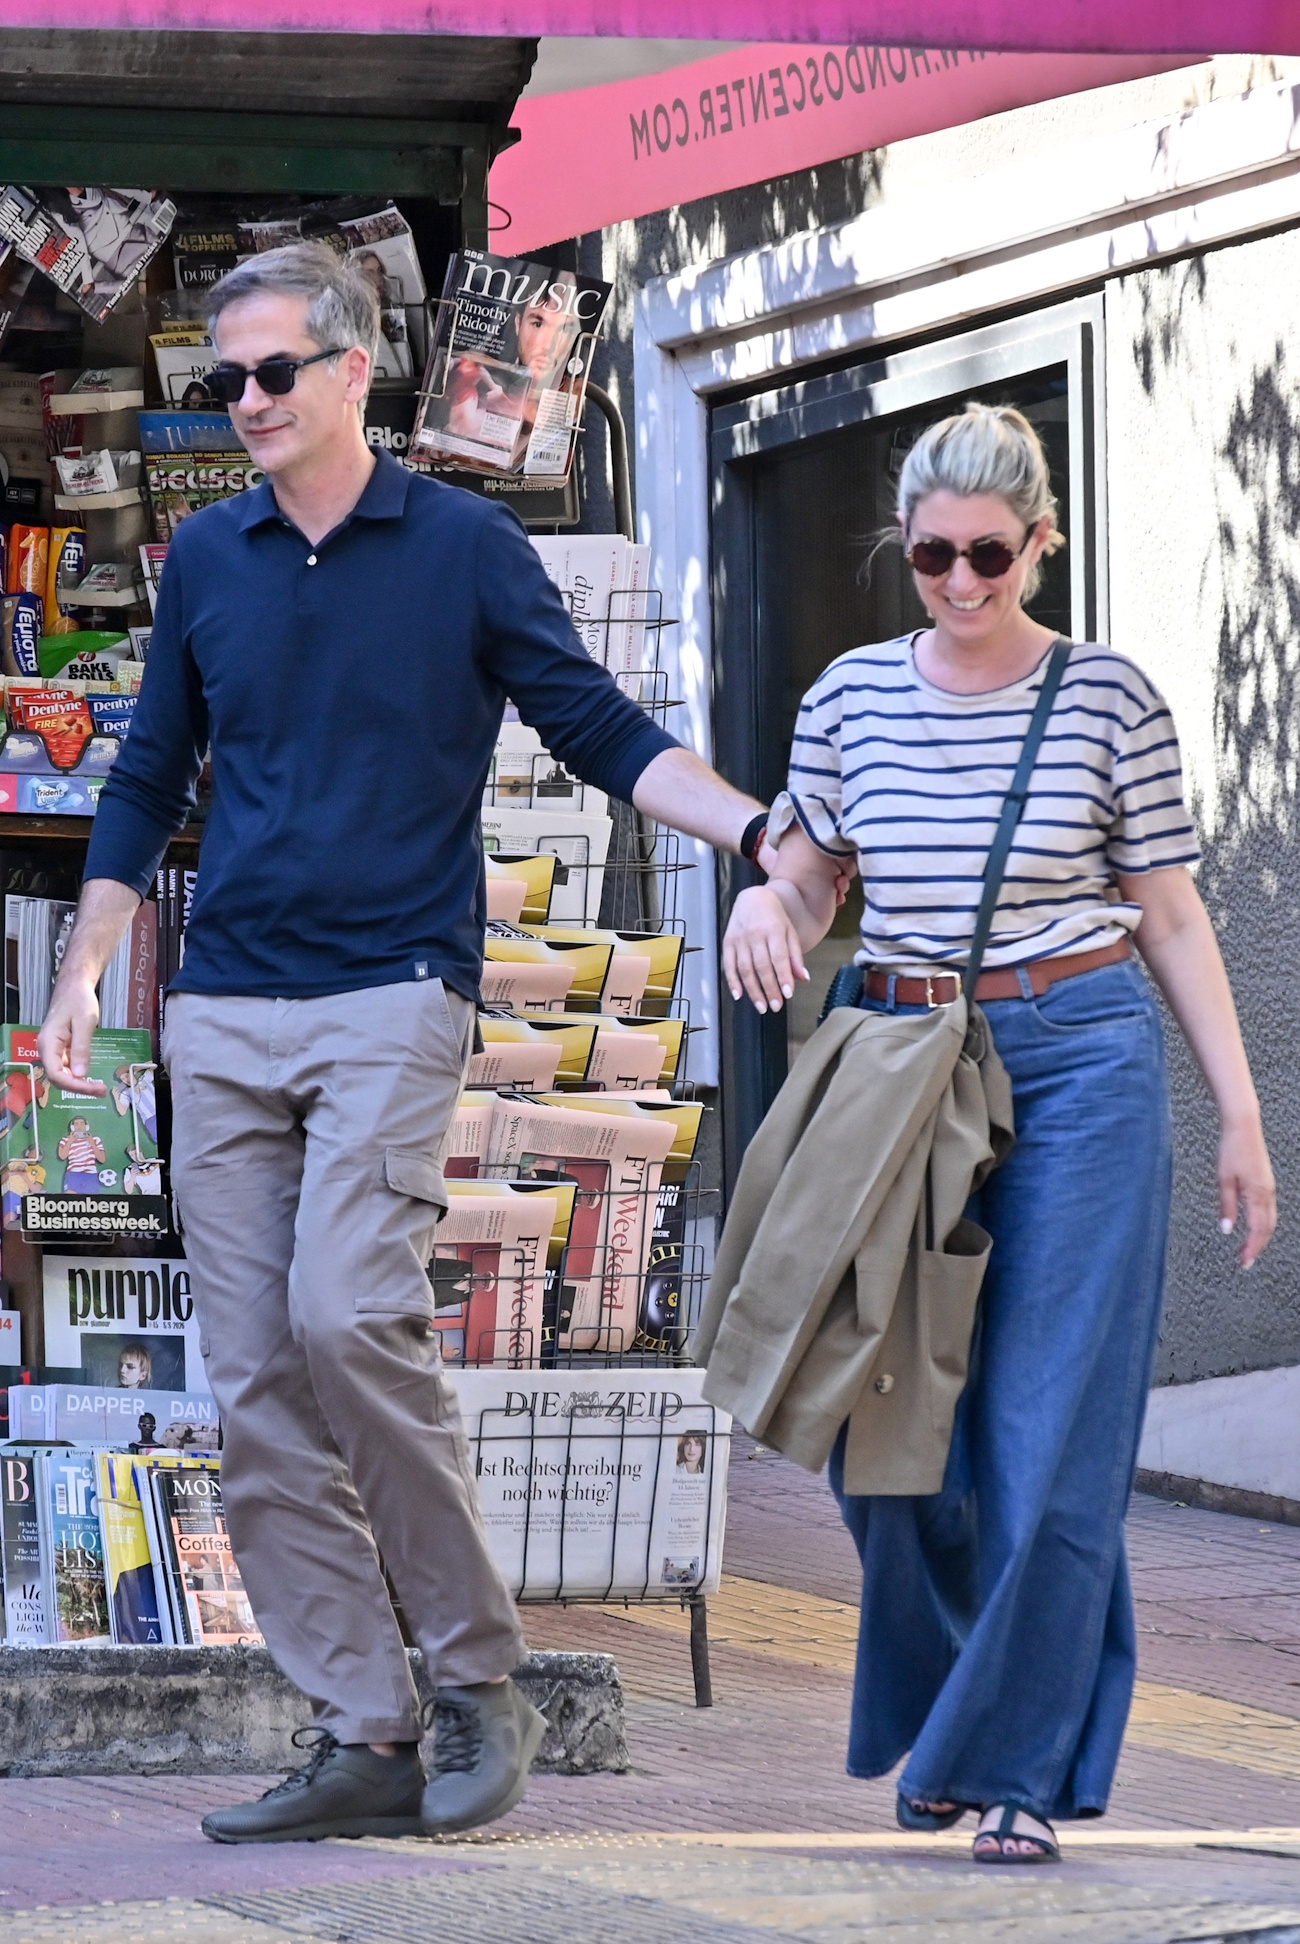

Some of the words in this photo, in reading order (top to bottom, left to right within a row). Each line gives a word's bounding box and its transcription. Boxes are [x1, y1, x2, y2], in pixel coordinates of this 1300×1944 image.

[7, 217, 31, 243] THE
[20, 219, 52, 257] ROOM
[190, 233, 236, 245] FILMS
[189, 244, 238, 252] OFFERTS
[66, 251, 83, 273] VIRAL
[458, 259, 602, 320] music
[457, 297, 511, 325] Timothy
[458, 314, 501, 336] Ridout
[162, 336, 191, 345] FILMS
[568, 576, 594, 635] diplo
[68, 662, 111, 674] BAKE
[29, 701, 82, 717] Dentyne
[93, 697, 138, 713] Dentyn
[35, 719, 58, 729] FIRE
[37, 789, 63, 797] Trident
[135, 921, 150, 984] Paper
[507, 1116, 523, 1150] SpaceX
[26, 1196, 130, 1216] Bloomberg
[27, 1212, 161, 1231] Businessweek
[68, 1263, 194, 1328] purple
[67, 1394, 146, 1415] DAPPER
[170, 1400, 211, 1420] DAN
[503, 1391, 561, 1418] DIE
[604, 1391, 683, 1418] ZEID
[478, 1456, 497, 1477] Ist
[502, 1455, 643, 1481] Rechtschreibung
[502, 1481, 542, 1501] noch
[547, 1481, 613, 1506] wichtig?
[179, 1537, 232, 1551] Coffee
[11, 1601, 41, 1611] CONS
[16, 1613, 44, 1622] LIGH
[17, 1624, 32, 1632] the
